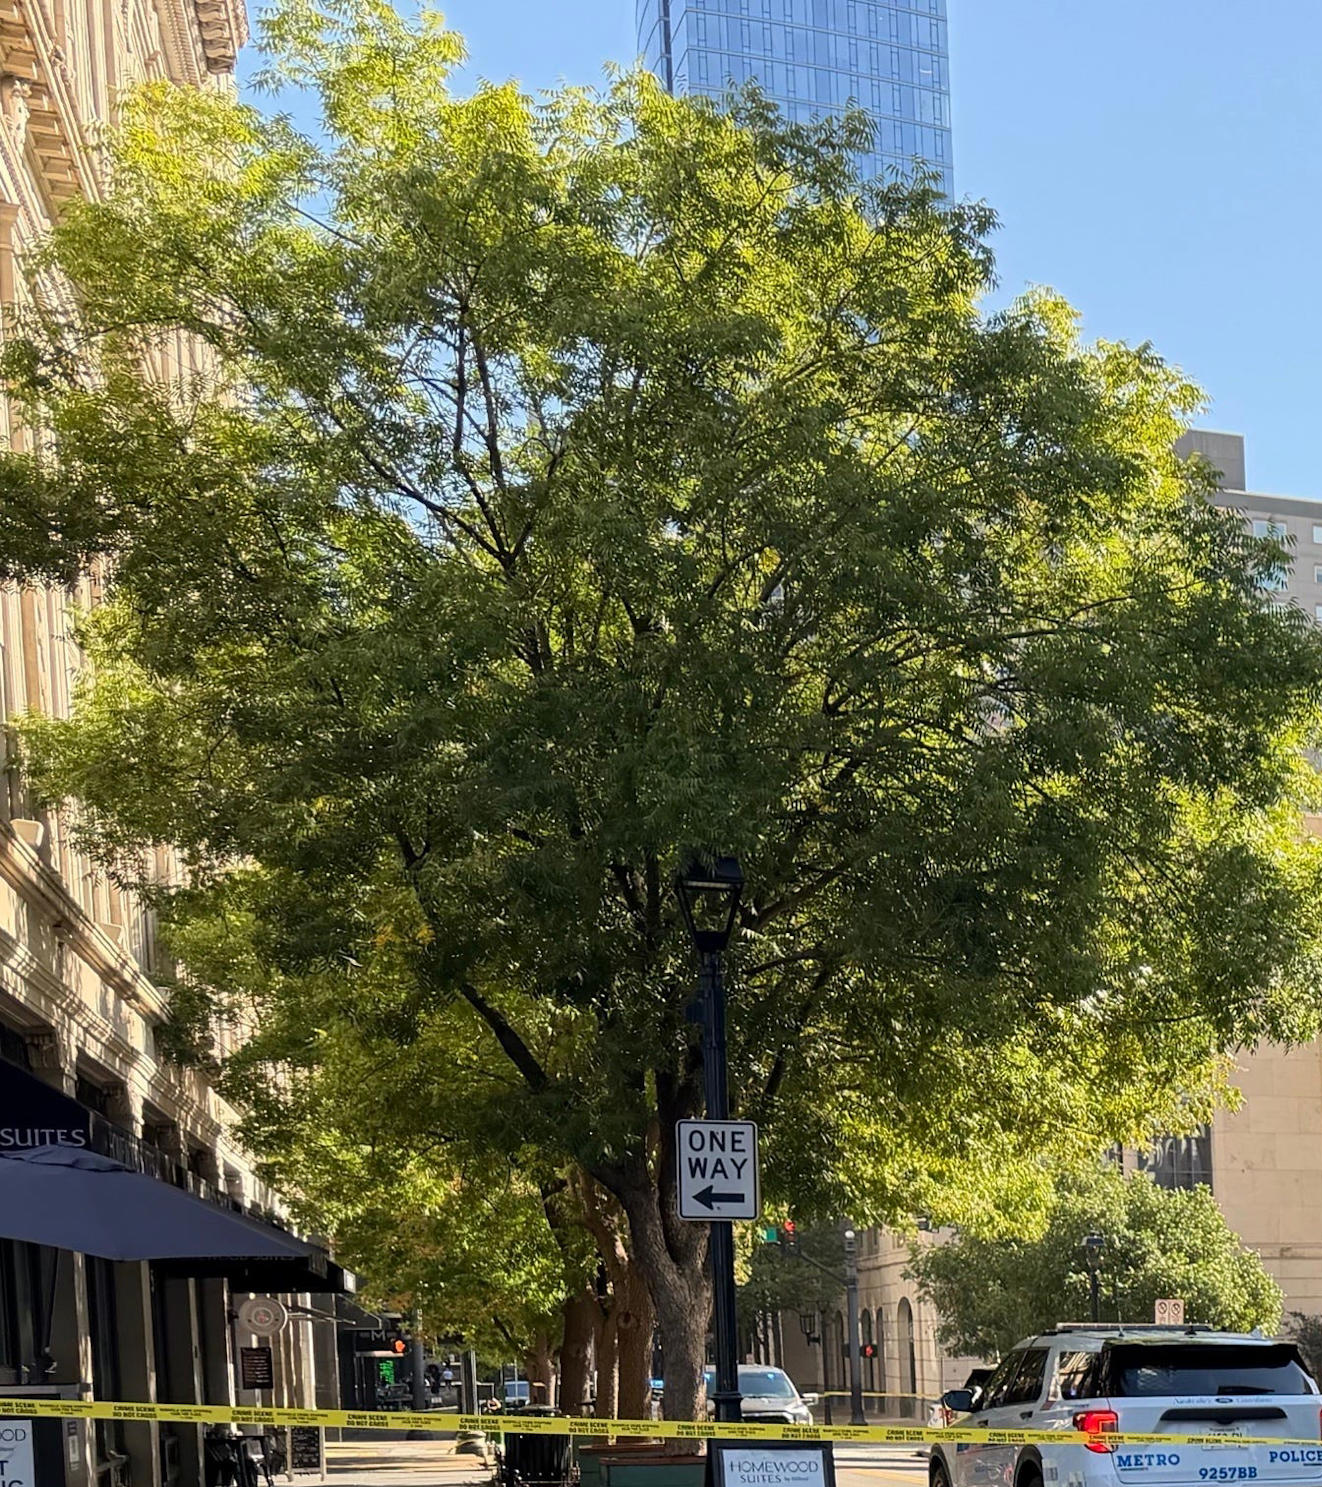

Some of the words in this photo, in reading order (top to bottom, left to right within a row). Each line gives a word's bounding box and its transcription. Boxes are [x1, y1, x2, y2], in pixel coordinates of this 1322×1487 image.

[0, 1128, 86, 1147] SUITES
[688, 1130, 746, 1153] ONE
[688, 1157, 748, 1179] WAY
[729, 1460, 819, 1473] HOMEWOOD
[1117, 1453, 1180, 1468] METRO
[740, 1474, 782, 1484] SUITES
[1199, 1466, 1257, 1480] 9257BB
